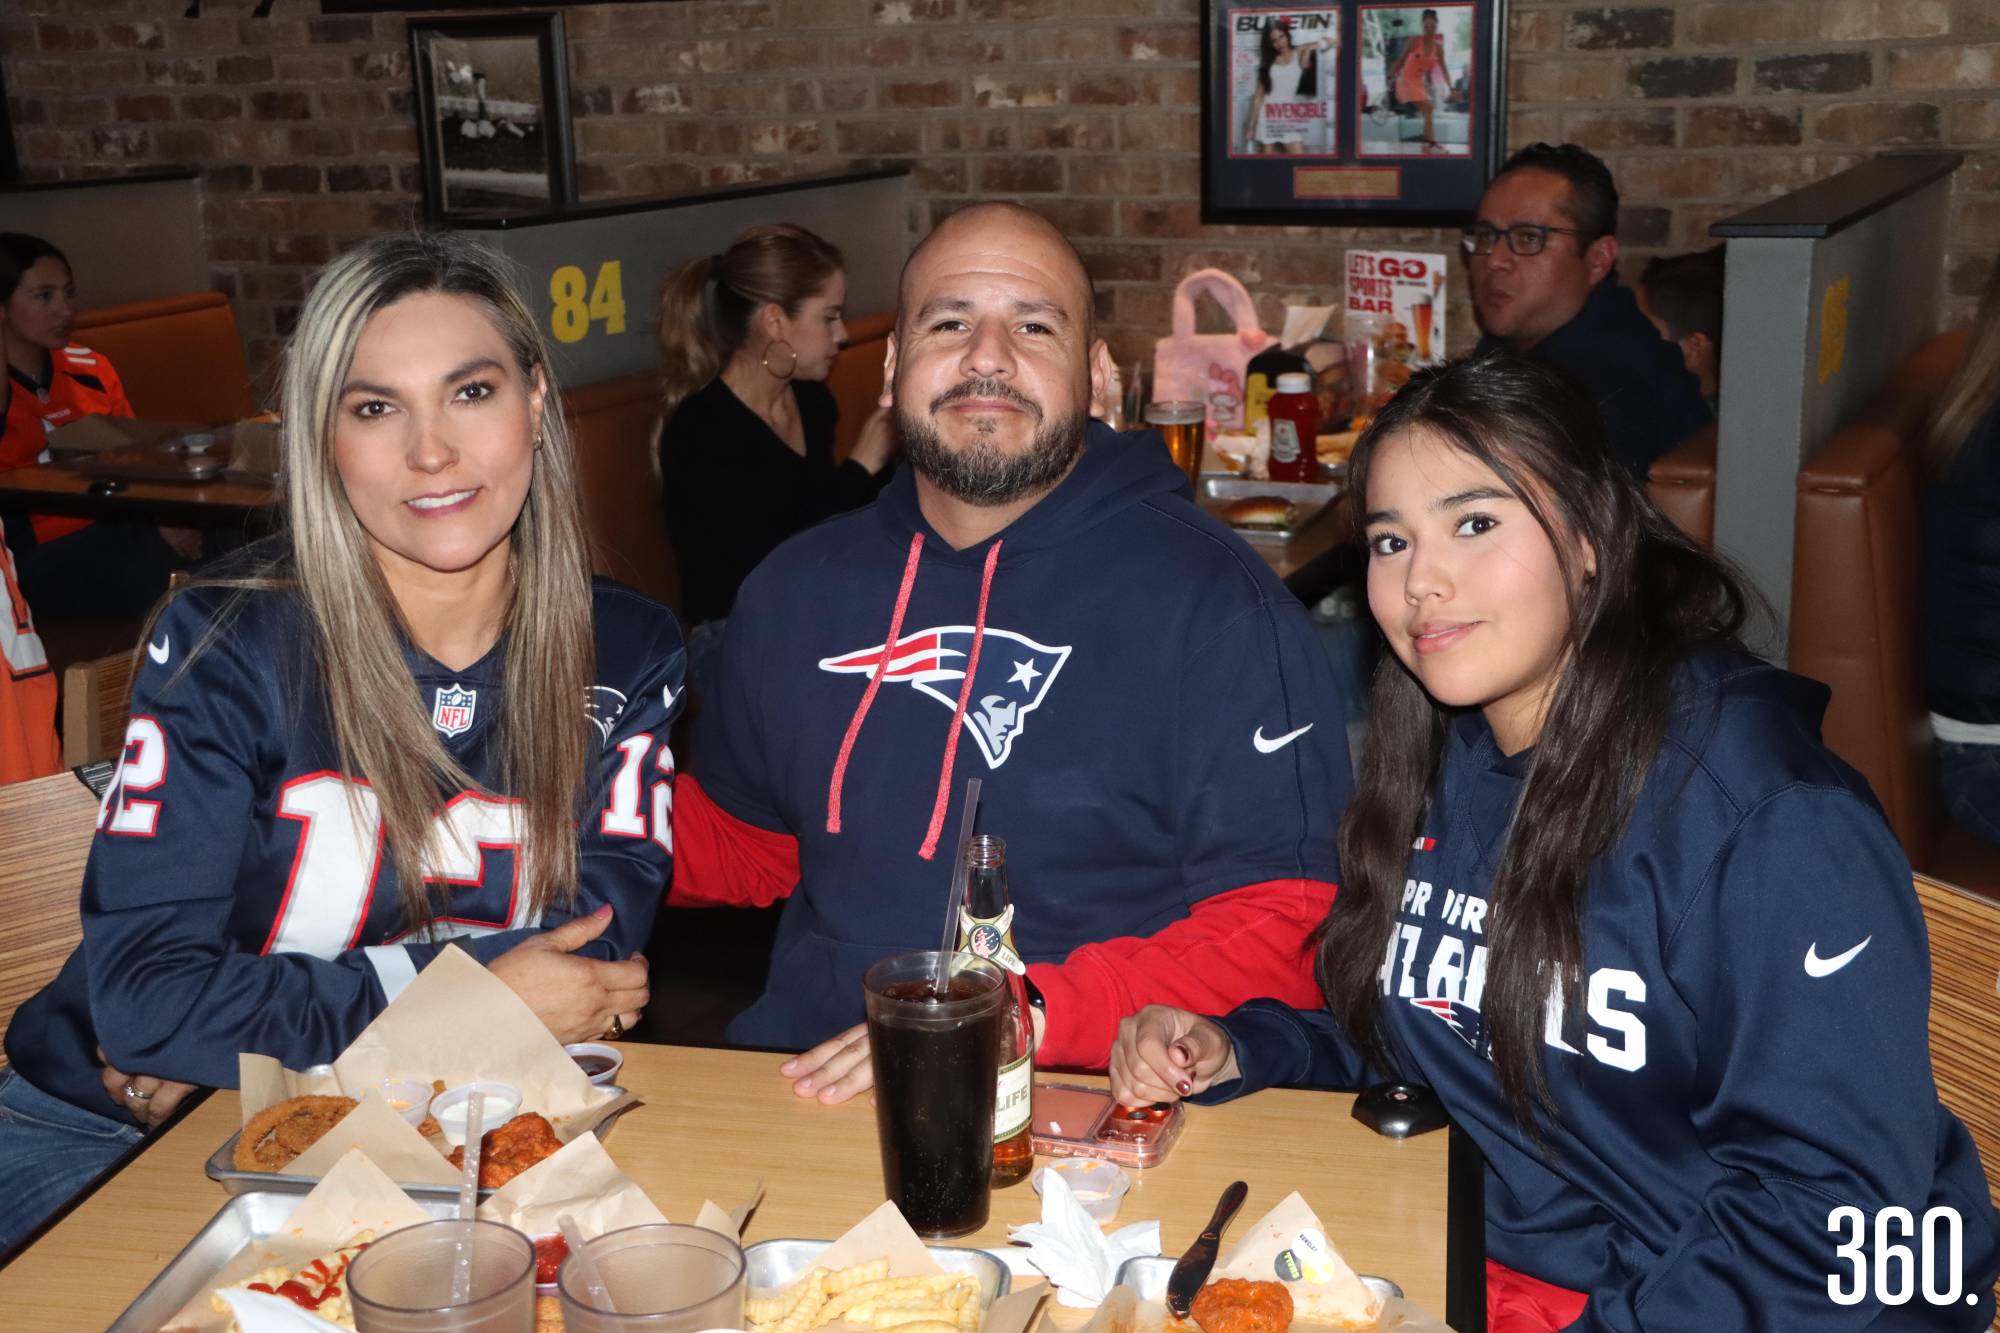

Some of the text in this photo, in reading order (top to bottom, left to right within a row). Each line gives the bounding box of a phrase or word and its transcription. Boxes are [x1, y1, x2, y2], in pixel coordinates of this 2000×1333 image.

[1348, 254, 1427, 280] LET'S GO
[1349, 275, 1393, 299] SPORTS
[550, 260, 626, 344] 84
[1348, 297, 1393, 315] BAR
[440, 706, 468, 728] NFL
[996, 1084, 1028, 1112] LIFE
